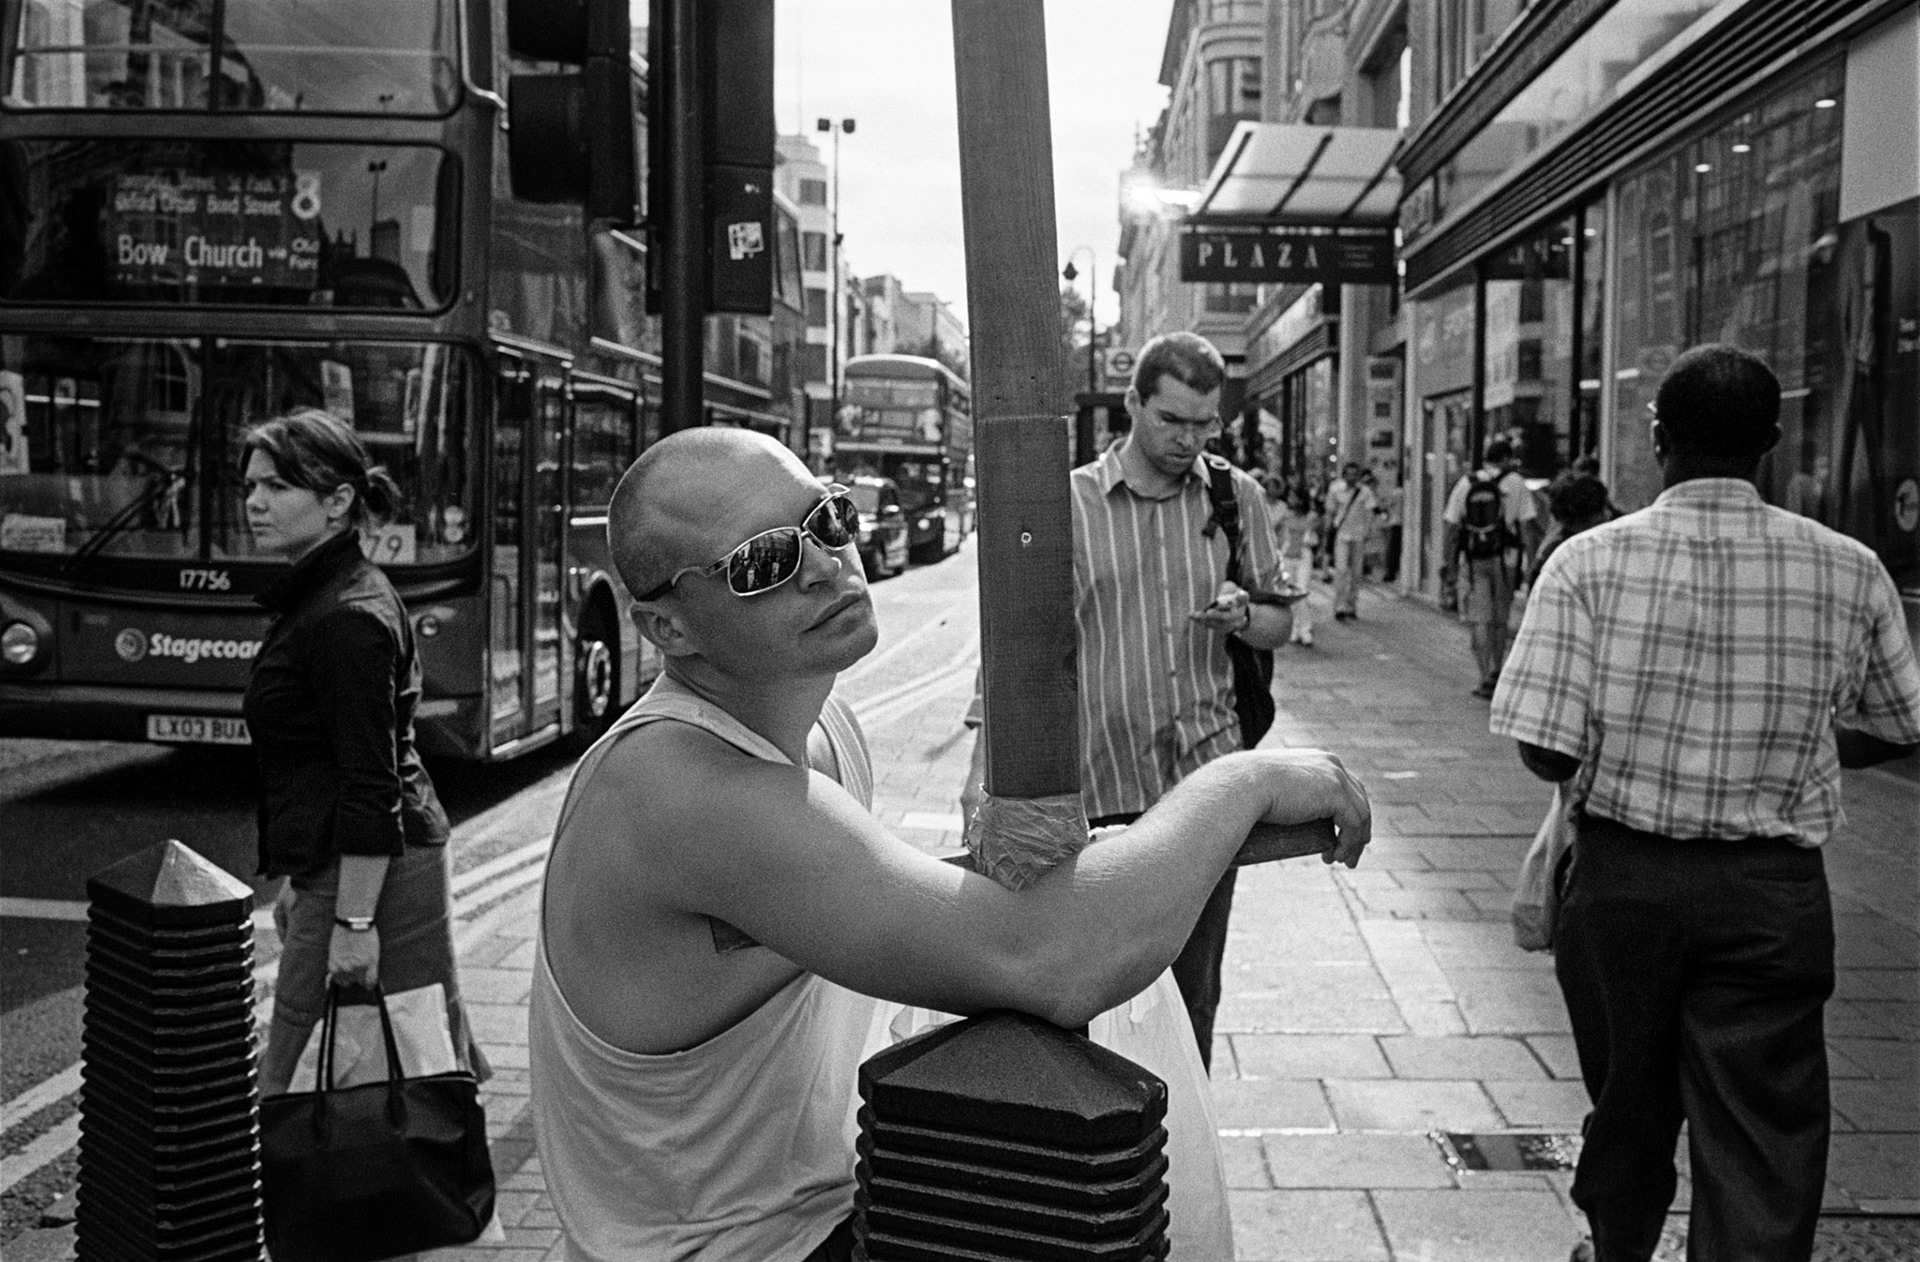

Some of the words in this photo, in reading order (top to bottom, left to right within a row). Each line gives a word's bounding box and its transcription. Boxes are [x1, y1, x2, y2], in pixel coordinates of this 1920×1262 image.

[291, 170, 322, 220] 8
[118, 234, 168, 265] Bow
[185, 235, 263, 268] Church
[1199, 242, 1320, 268] PLAZA
[179, 568, 231, 591] 17756
